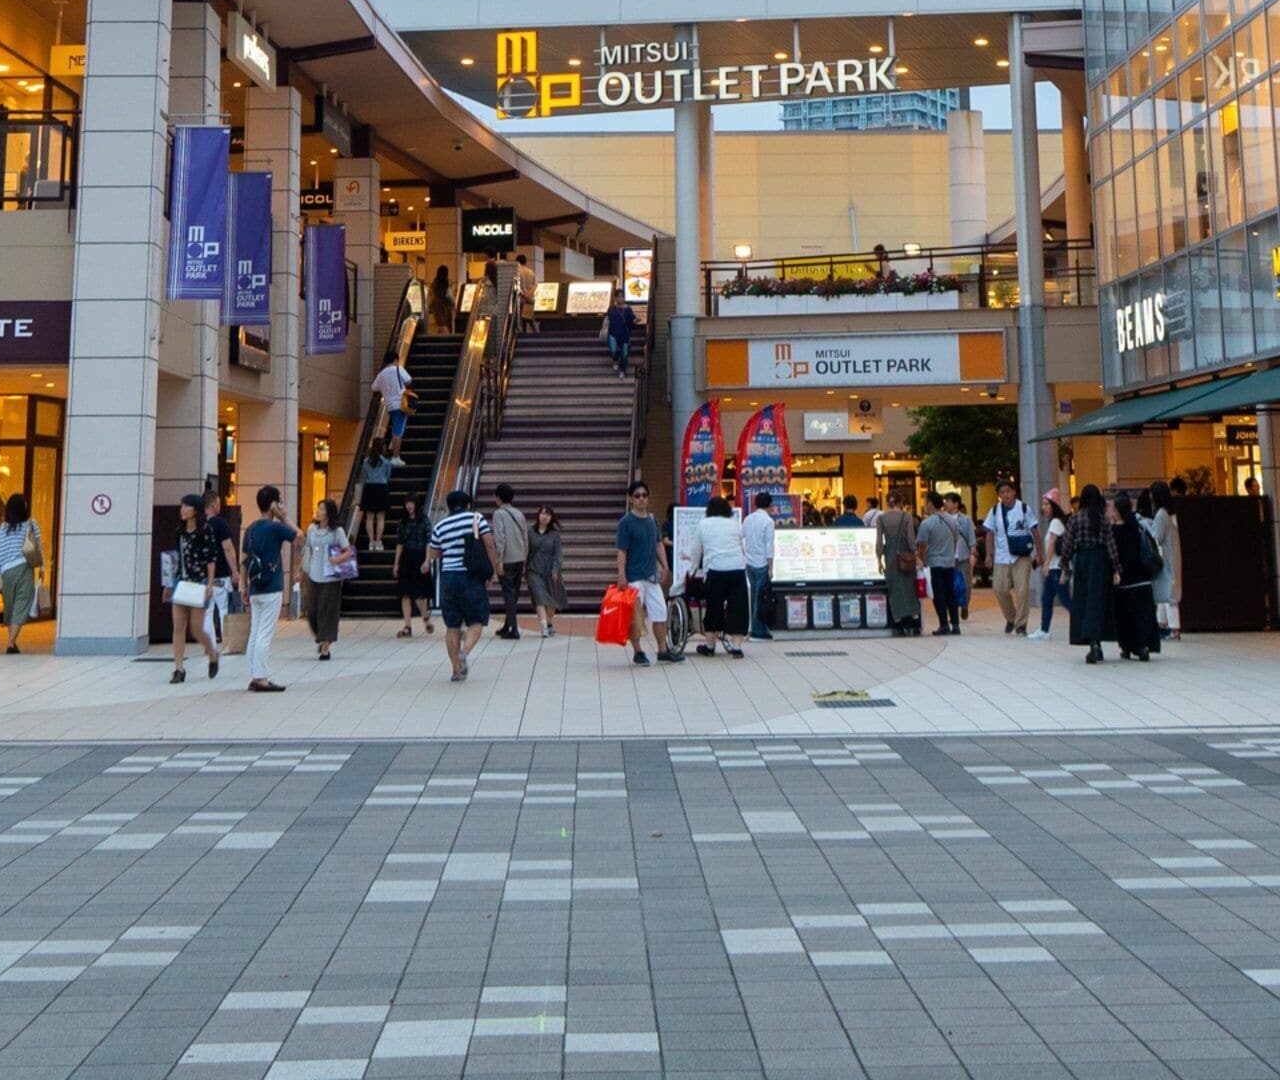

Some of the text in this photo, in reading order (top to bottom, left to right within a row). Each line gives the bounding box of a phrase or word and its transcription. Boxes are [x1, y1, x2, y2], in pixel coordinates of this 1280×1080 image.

[600, 41, 690, 66] MITSUI
[597, 56, 897, 107] OUTLET PARK
[472, 223, 513, 236] NICOLE
[185, 264, 218, 272] OUTLET
[185, 272, 207, 280] PARK
[1116, 293, 1167, 353] BEAMS
[815, 350, 850, 358] MITSUI
[815, 358, 932, 375] OUTLET PARK
